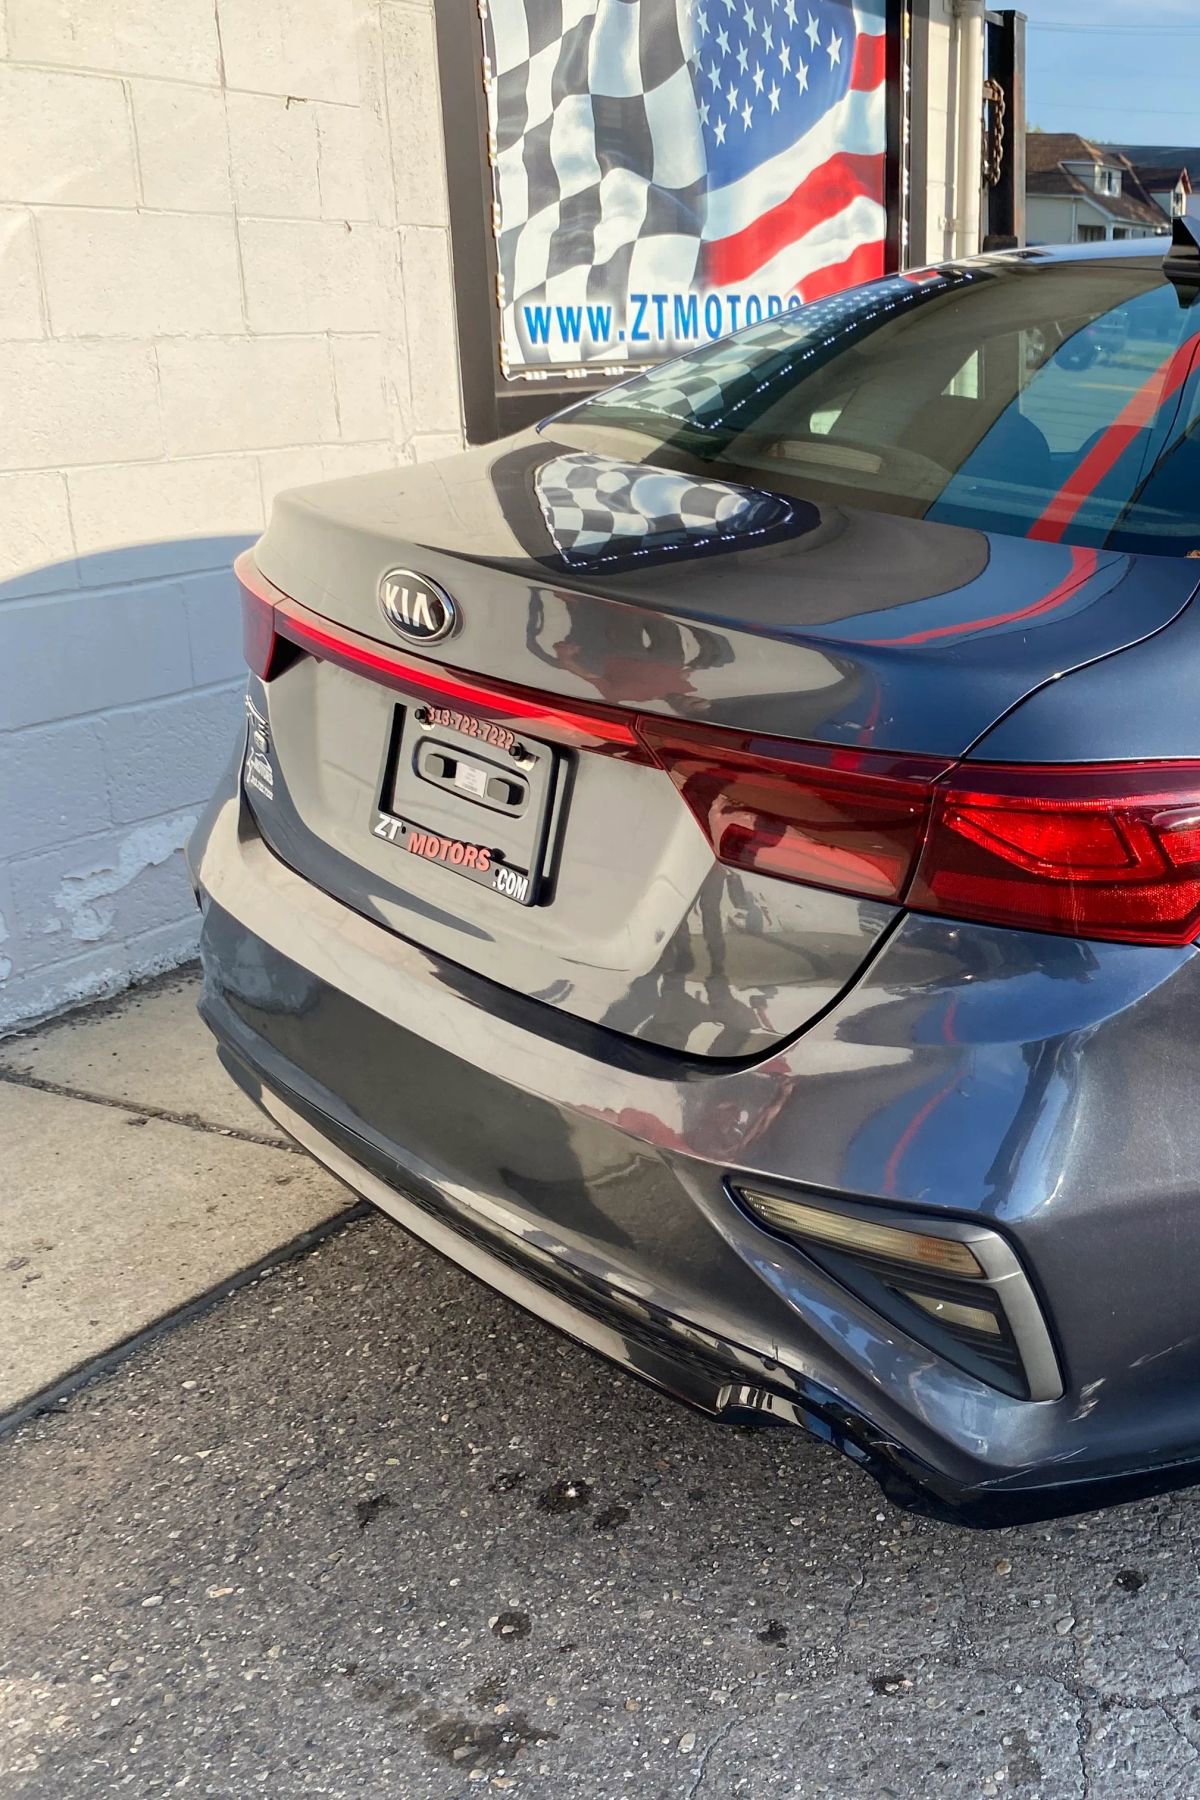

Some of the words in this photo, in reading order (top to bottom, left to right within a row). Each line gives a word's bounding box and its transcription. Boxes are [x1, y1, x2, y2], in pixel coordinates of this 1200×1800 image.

[523, 294, 801, 344] www.ZTMOTO
[385, 582, 435, 631] KIA
[374, 813, 403, 841] ZT
[408, 832, 491, 871] MOTORS
[492, 868, 530, 901] .COM
